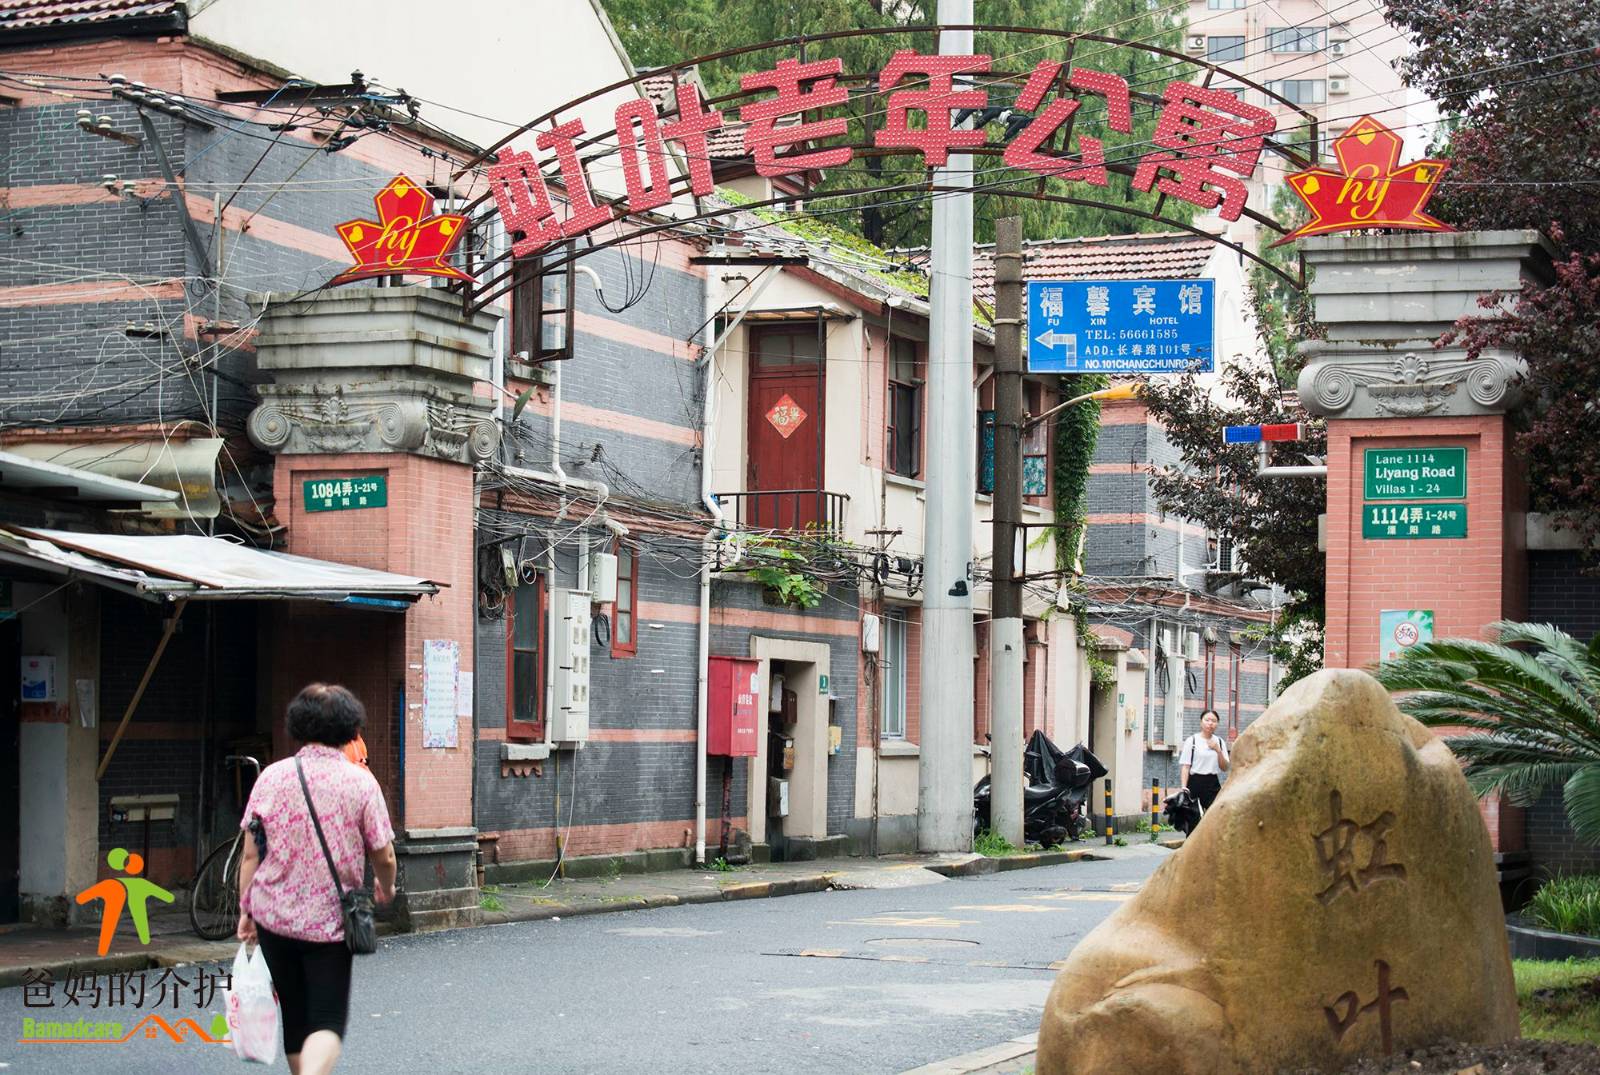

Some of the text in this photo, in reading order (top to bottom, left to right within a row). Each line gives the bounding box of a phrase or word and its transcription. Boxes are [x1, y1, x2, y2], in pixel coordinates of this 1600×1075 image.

[486, 49, 1277, 259] 虹叶老年公寓
[1040, 284, 1203, 318] 福馨宾馆
[1047, 317, 1180, 326] FU XIN HOTEL
[1085, 329, 1178, 340] TEL: 56661585
[1085, 346, 1114, 356] ADD:
[1375, 454, 1435, 464] Lane 1114
[1375, 466, 1456, 481] Liyang Road
[1375, 484, 1406, 494] Villas
